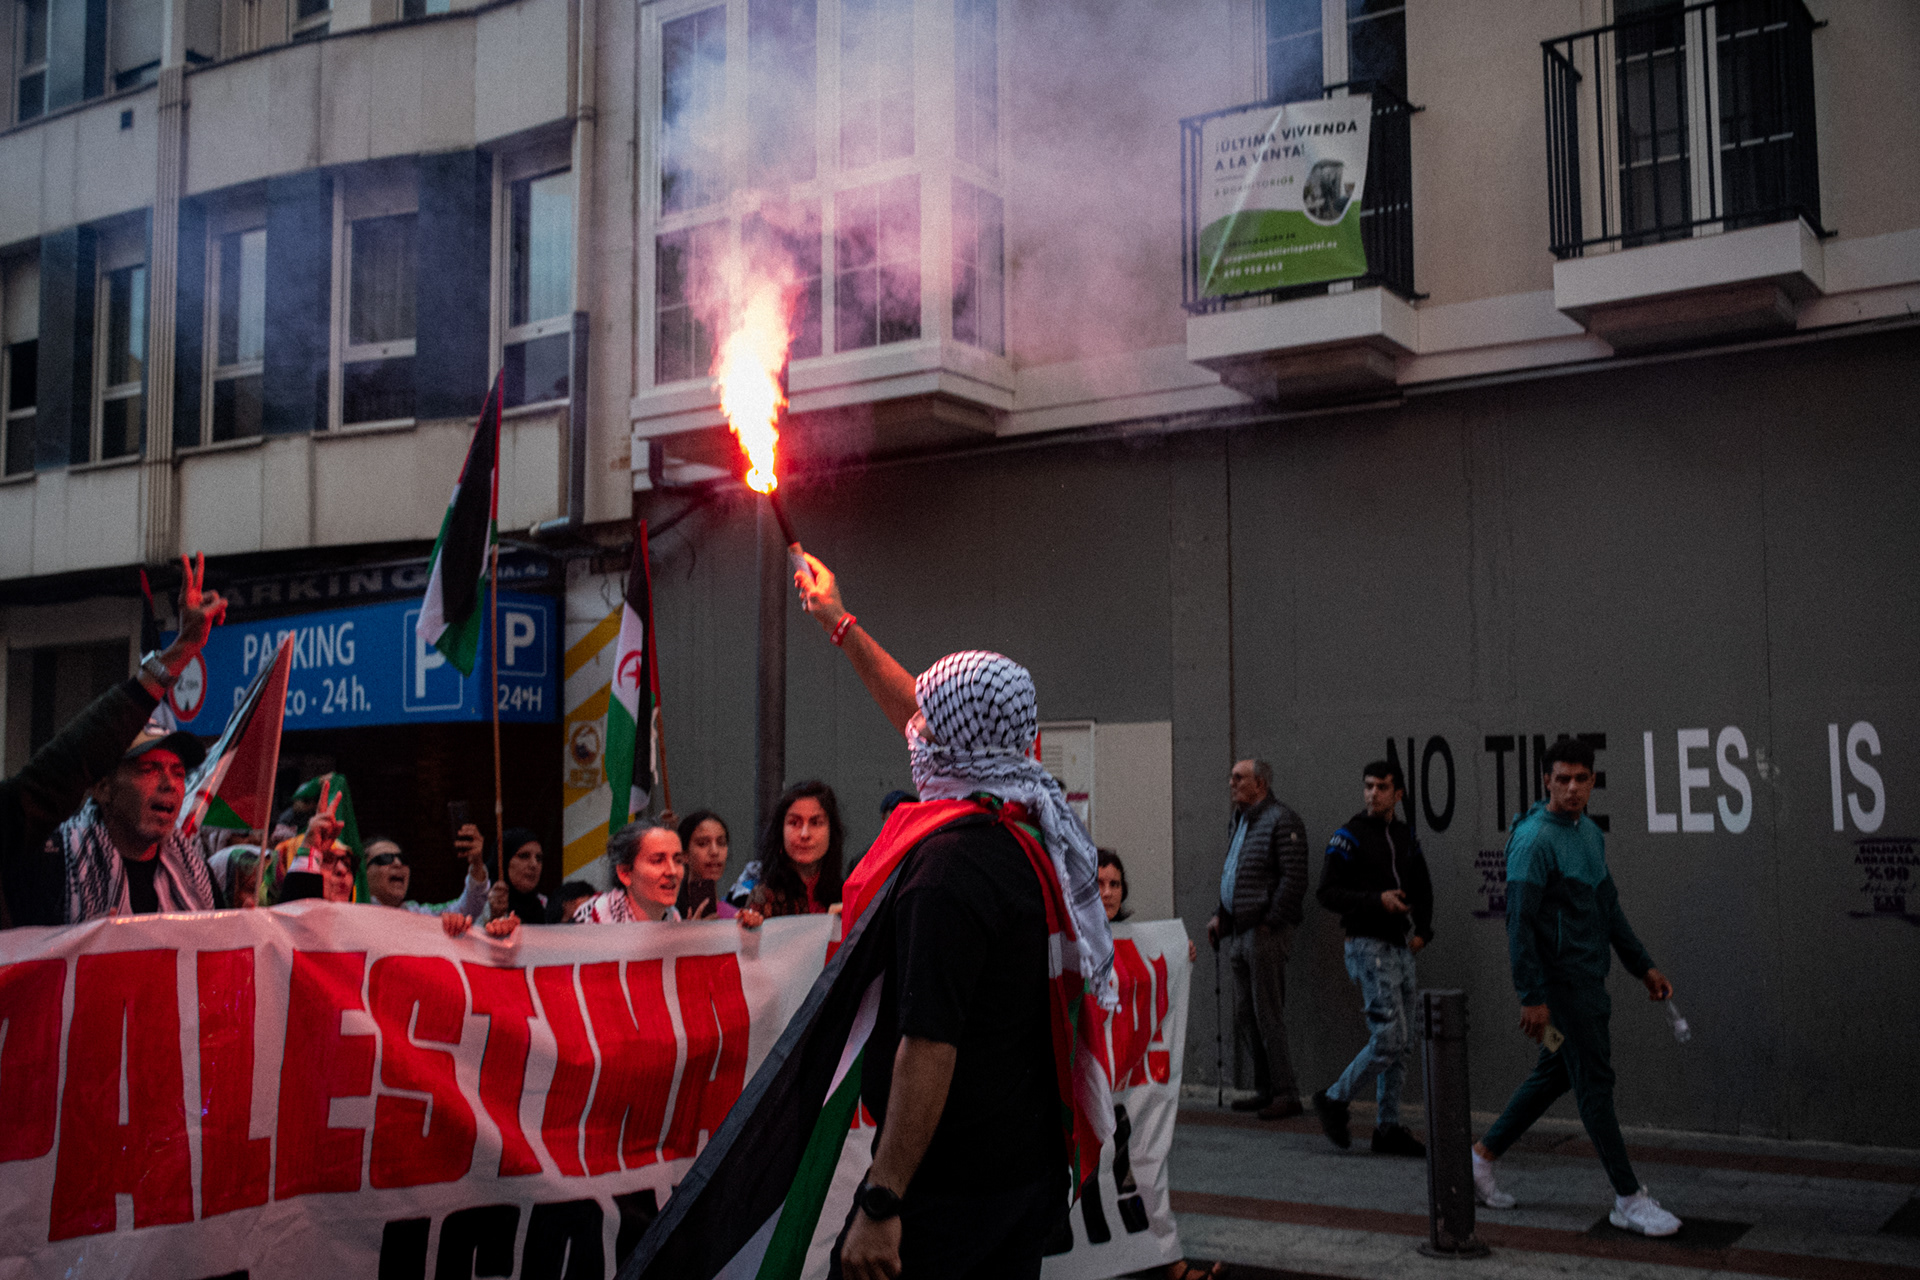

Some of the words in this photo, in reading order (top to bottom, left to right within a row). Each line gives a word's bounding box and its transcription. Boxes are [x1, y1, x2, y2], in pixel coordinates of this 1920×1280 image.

[1281, 120, 1358, 141] VIVIENDA
[1214, 159, 1224, 172] A
[1229, 155, 1247, 169] LA
[224, 566, 428, 608] ARKING
[505, 612, 536, 666] P
[1386, 735, 1456, 833] NO
[1643, 726, 1753, 834] LES
[1828, 721, 1886, 833] IS
